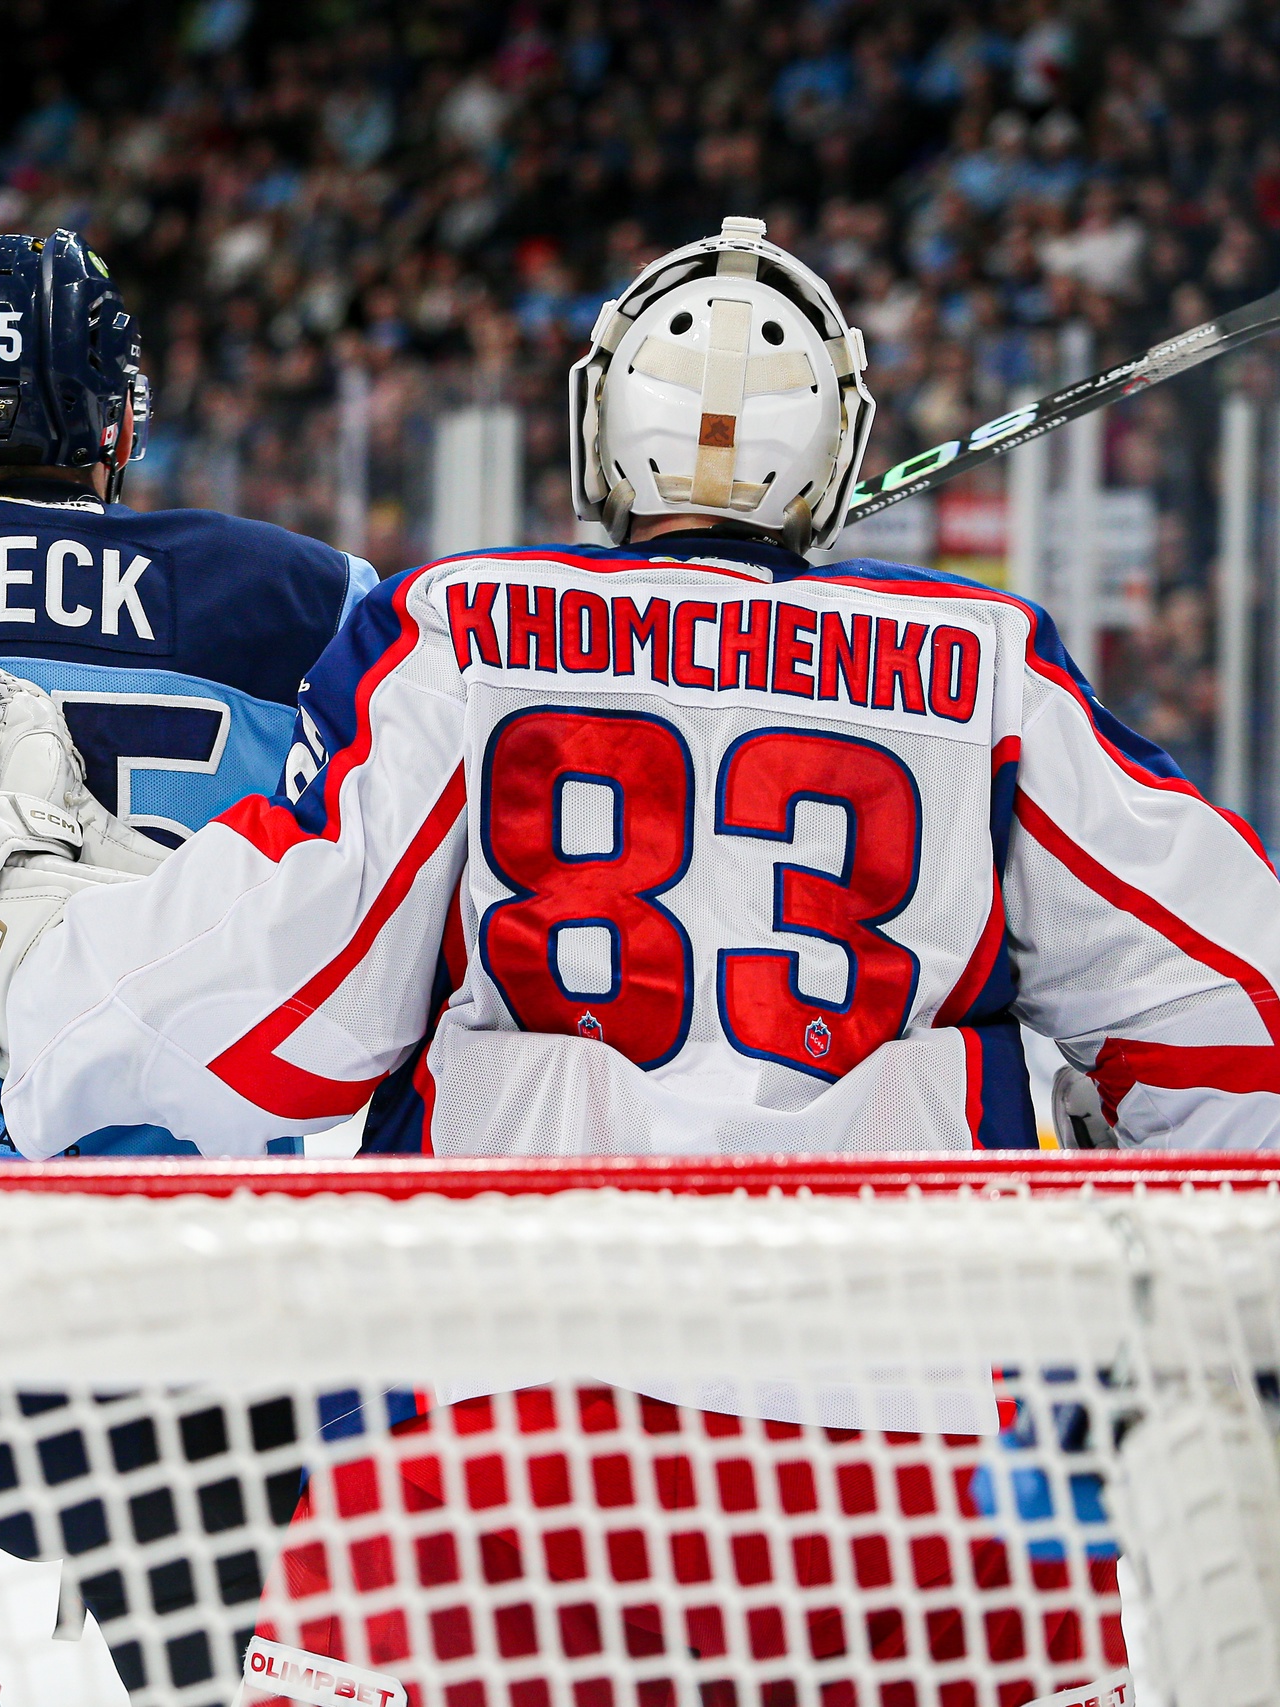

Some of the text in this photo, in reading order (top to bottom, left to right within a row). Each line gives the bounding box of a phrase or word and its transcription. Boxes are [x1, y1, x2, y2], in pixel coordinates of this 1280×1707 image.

[446, 581, 981, 724] KHOMCHENKO
[29, 808, 76, 835] CCM
[50, 689, 232, 851] 5
[479, 703, 923, 1086] 83
[250, 1652, 395, 1707] OLIMPBET
